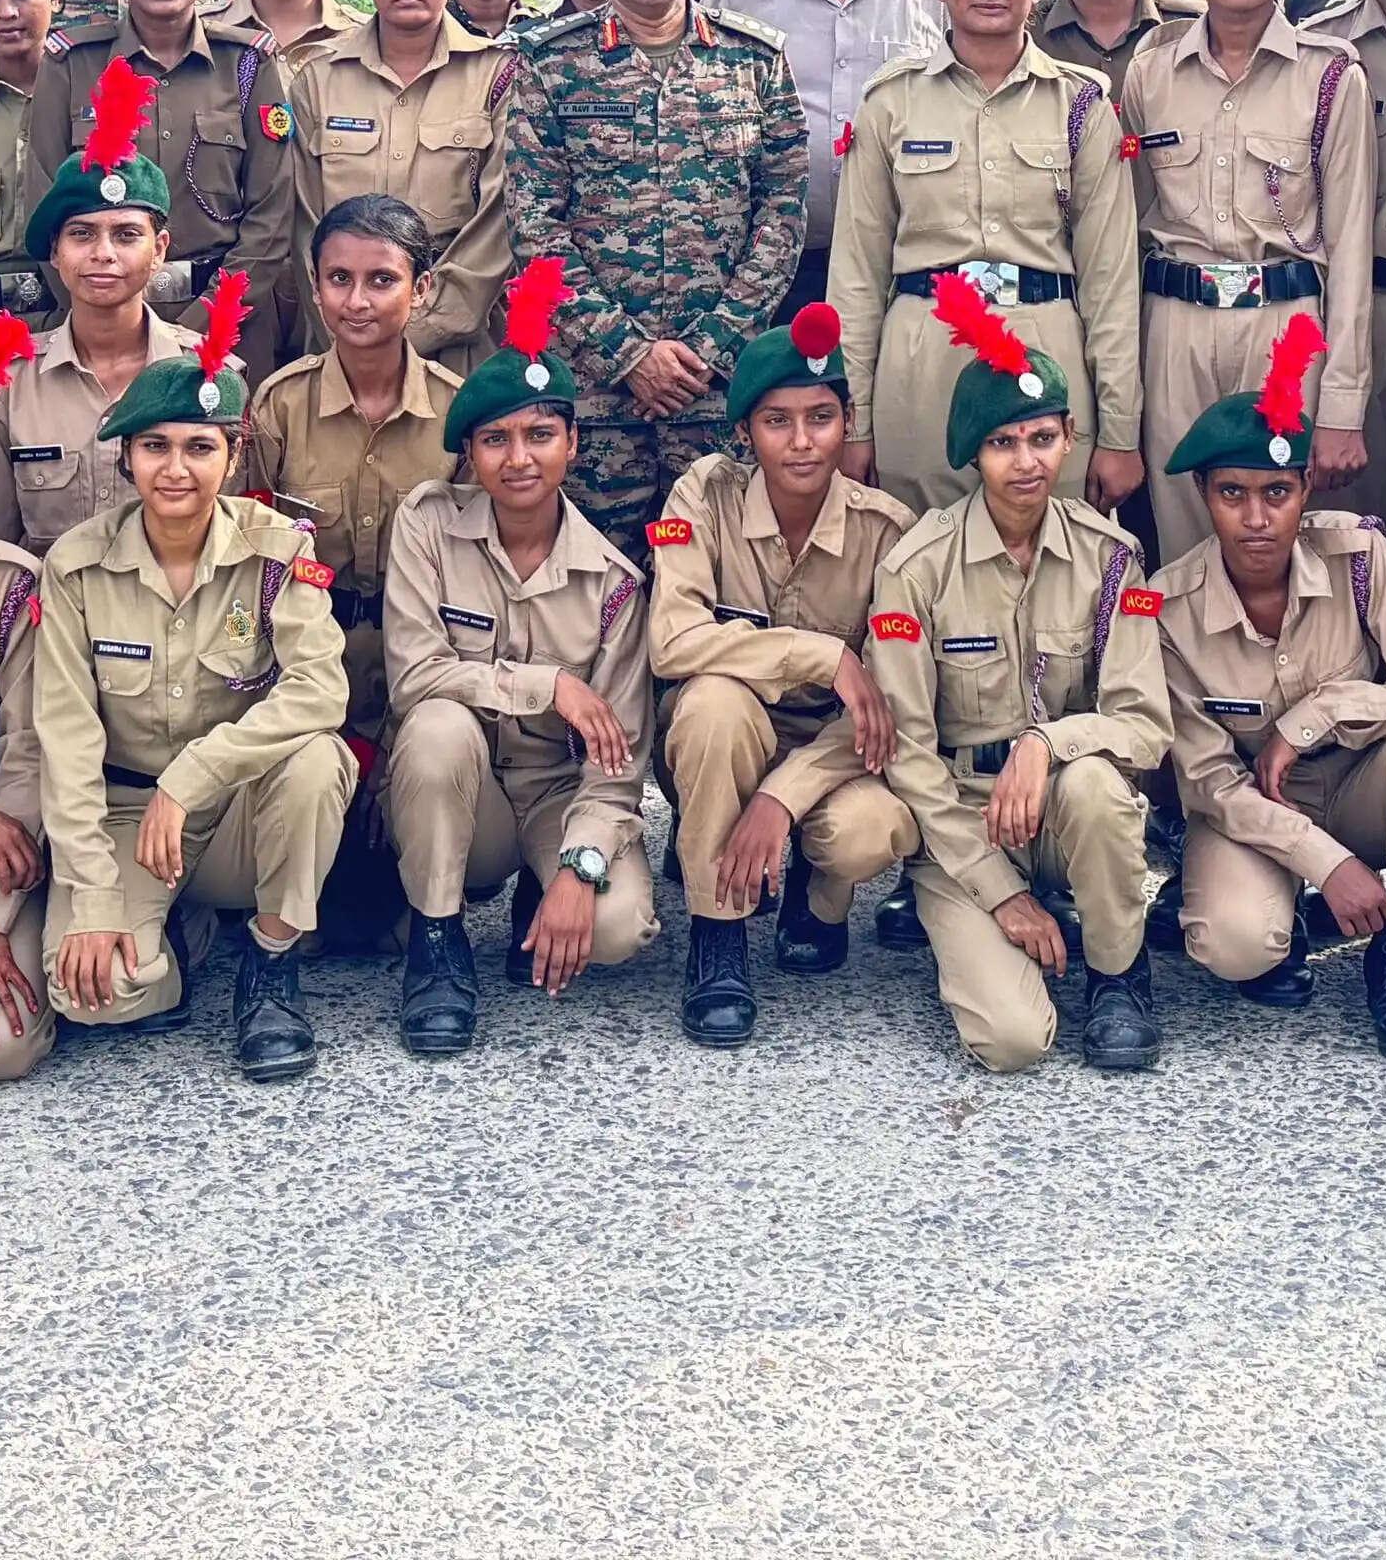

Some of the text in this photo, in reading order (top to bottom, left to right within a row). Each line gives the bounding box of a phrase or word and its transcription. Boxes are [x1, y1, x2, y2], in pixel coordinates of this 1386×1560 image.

[572, 104, 590, 113] RAVI
[593, 104, 630, 113] SHANKAR
[655, 523, 687, 539] NCC
[296, 559, 328, 583] NCC
[1126, 594, 1153, 610] NCC
[880, 619, 913, 635] NCC
